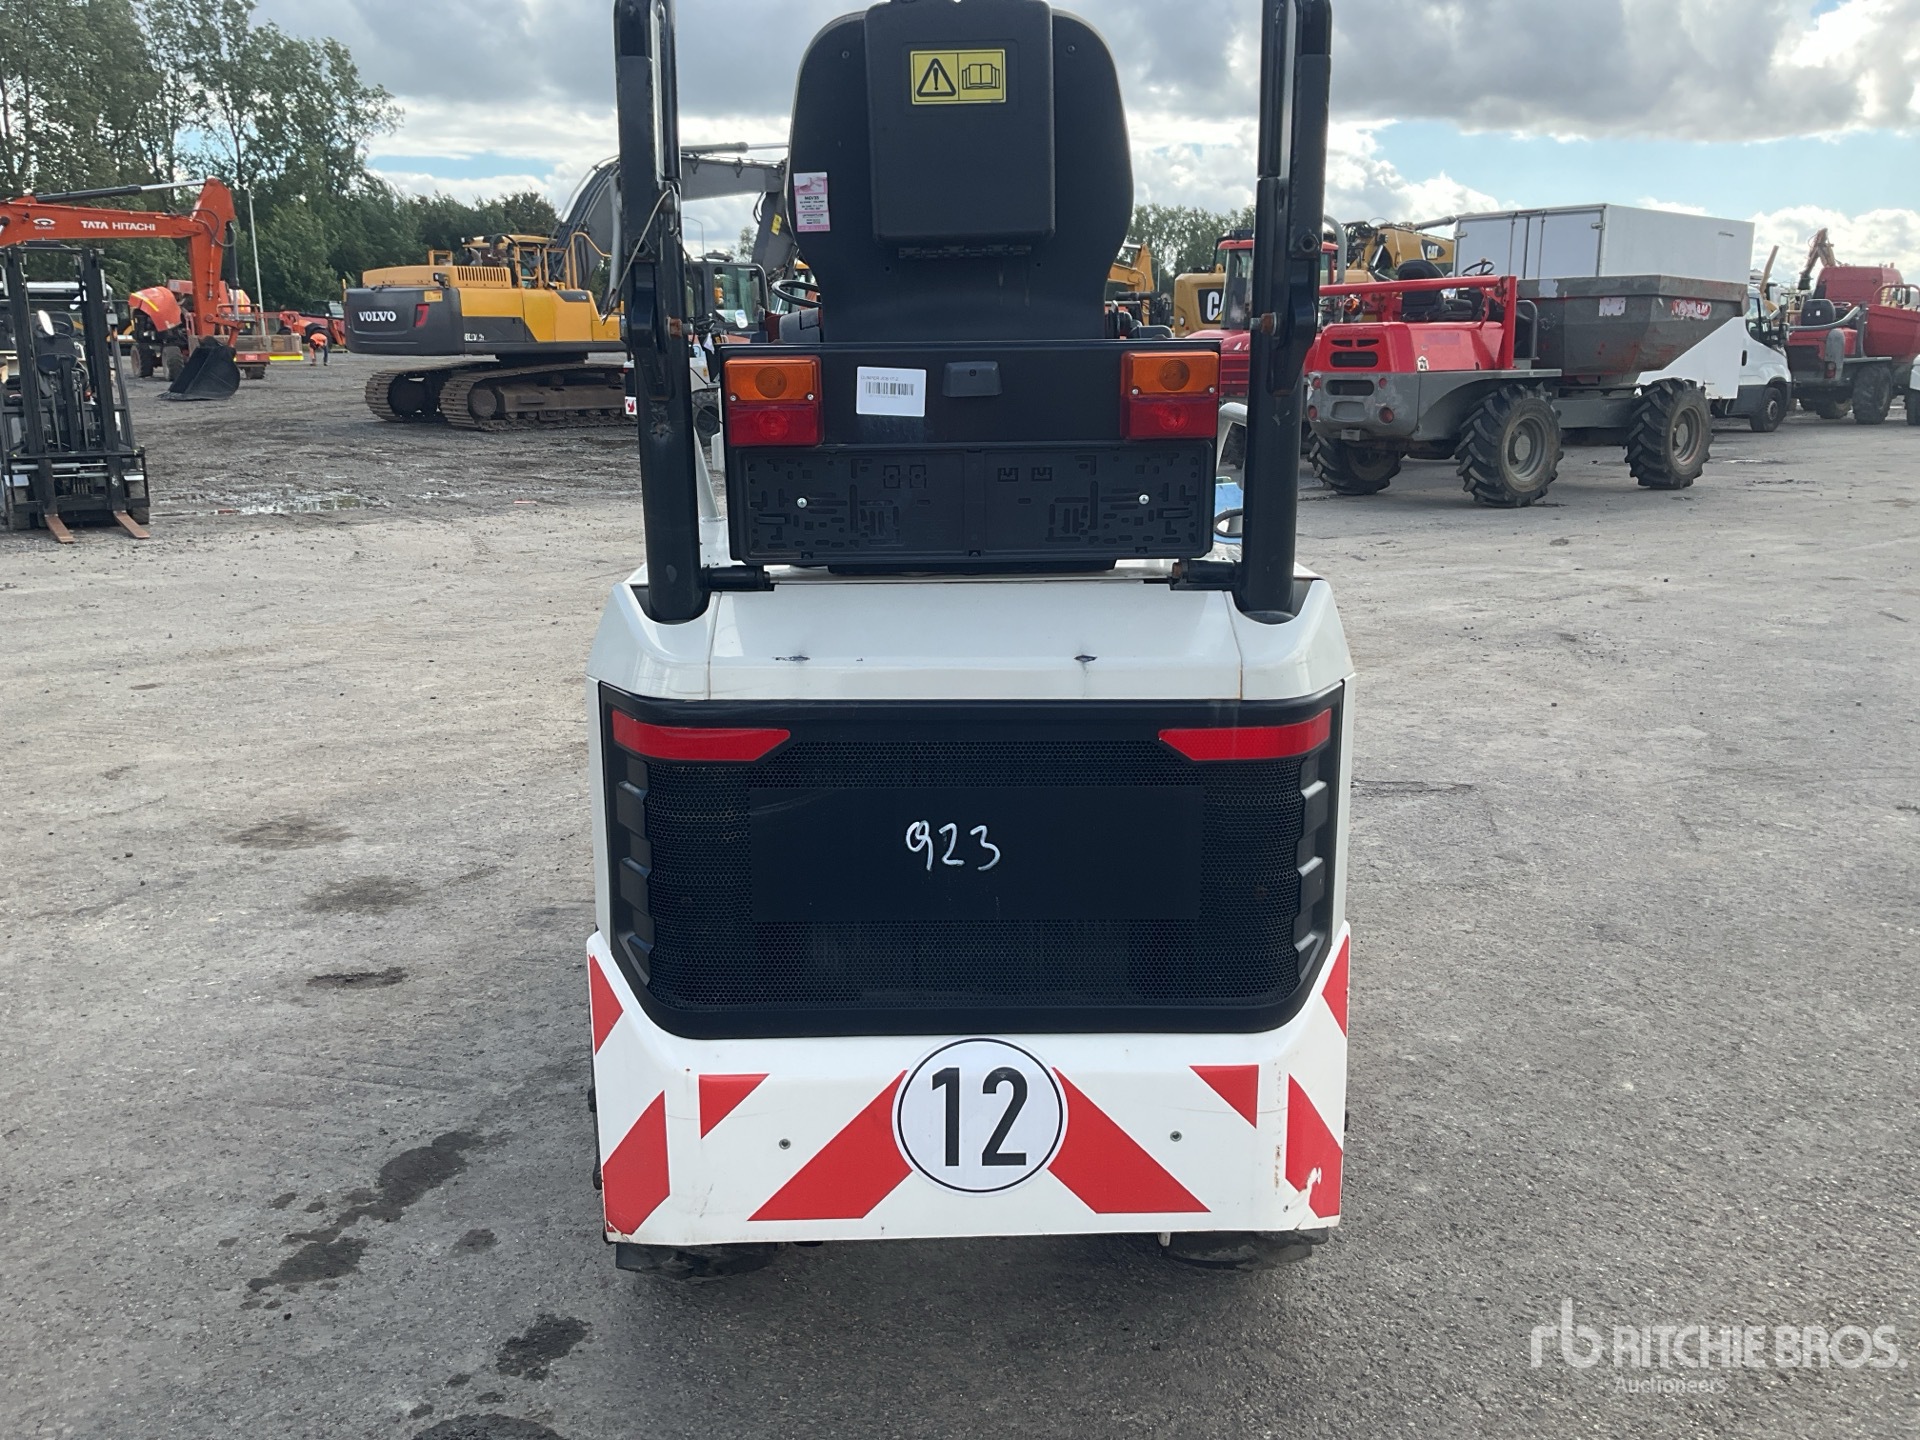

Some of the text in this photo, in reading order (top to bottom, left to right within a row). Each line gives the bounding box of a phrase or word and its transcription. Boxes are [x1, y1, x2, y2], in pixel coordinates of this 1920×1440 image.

[81, 220, 156, 231] TATA HITACHI
[1426, 245, 1439, 259] CAT
[358, 311, 397, 322] VOLVO
[905, 820, 1001, 871] 923
[932, 1066, 1028, 1167] 12
